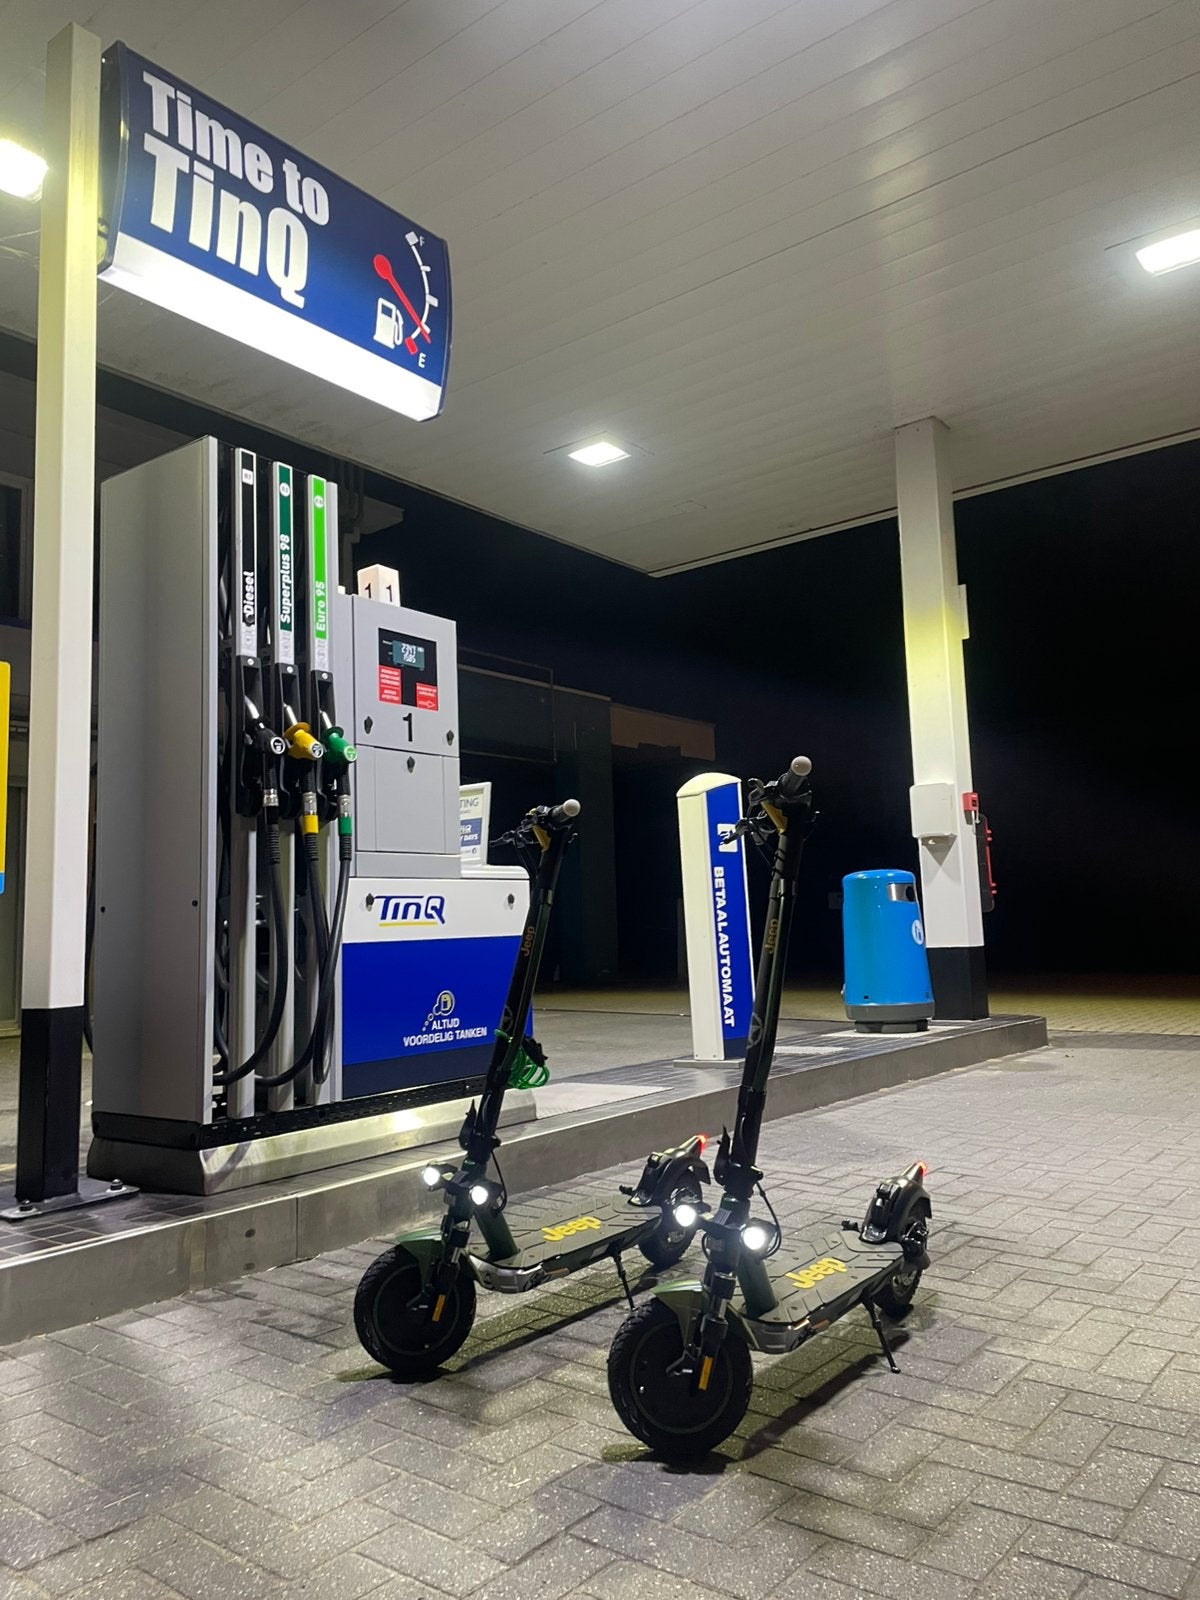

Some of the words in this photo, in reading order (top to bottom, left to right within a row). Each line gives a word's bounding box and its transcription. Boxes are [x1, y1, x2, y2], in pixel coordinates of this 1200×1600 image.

[143, 71, 274, 194] Time
[282, 158, 329, 226] to
[144, 132, 309, 309] TinQ
[418, 352, 426, 368] E
[279, 533, 290, 551] 98
[242, 570, 254, 617] Diesel
[280, 553, 292, 624] Superplus
[315, 581, 325, 598] 95
[364, 582, 371, 599] 1
[386, 584, 392, 602] 1
[316, 599, 326, 632] Euro
[403, 713, 413, 742] 1
[374, 895, 446, 924] TinQ
[521, 926, 535, 957] Jeep
[713, 866, 735, 1027] BETAALAUTOMAAT
[764, 918, 778, 955] Jeep
[403, 1031, 454, 1047] VOORDELIG
[455, 1027, 488, 1040] TANKEN
[431, 1018, 460, 1031] ALTIJD
[541, 1216, 601, 1241] Jeep
[785, 1257, 848, 1289] Jeep
